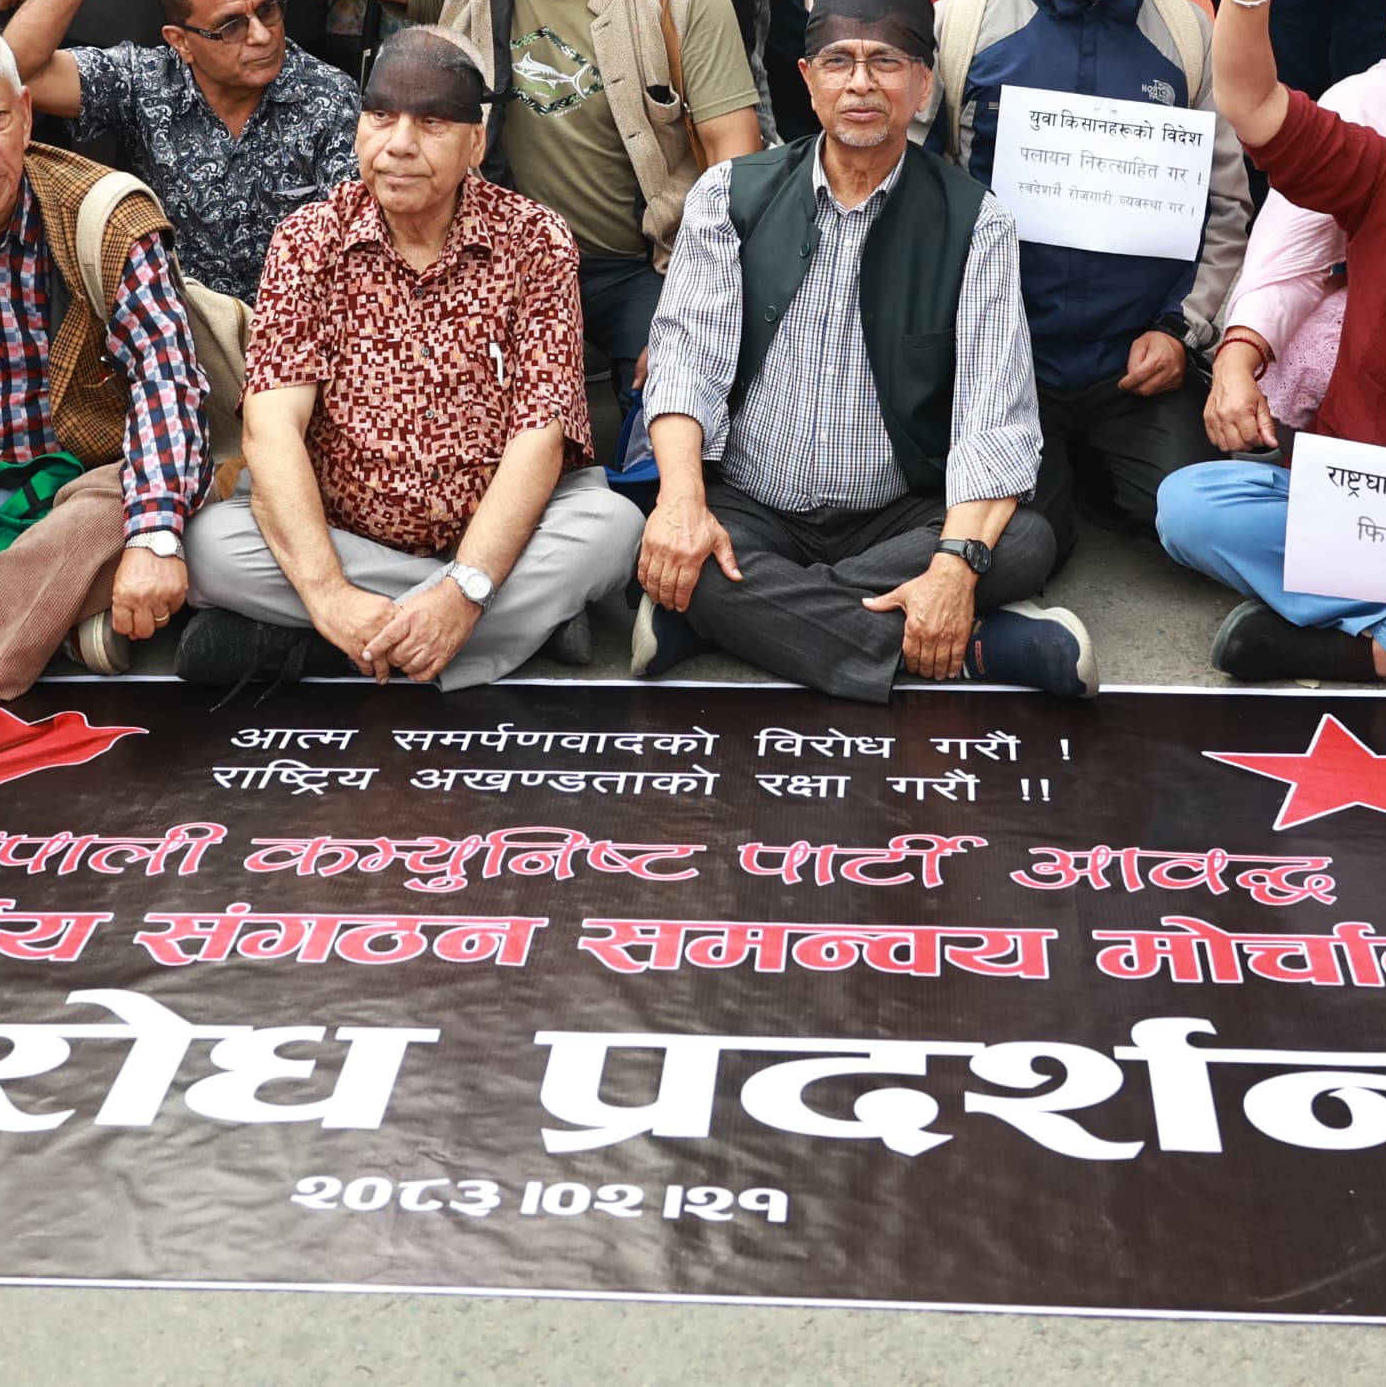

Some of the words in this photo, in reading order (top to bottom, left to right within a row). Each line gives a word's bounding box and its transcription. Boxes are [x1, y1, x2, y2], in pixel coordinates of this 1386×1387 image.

[1029, 110, 1057, 131] युवा
[1162, 122, 1204, 147] विदेश
[1019, 146, 1072, 167] पलायन
[1167, 165, 1190, 183] गर
[1068, 184, 1114, 205] रोजगारी
[1167, 201, 1187, 215] गर
[229, 726, 360, 751] आत्म
[391, 722, 721, 757] समर्पणवादको
[753, 726, 896, 759] विरोध
[211, 758, 381, 795] राष्ट्रिय
[409, 763, 721, 796] अखण्डताको
[754, 773, 852, 799] रक्षा
[242, 825, 708, 894] कम्युनिष्ट
[1008, 844, 1338, 906] आवद्ध
[132, 901, 550, 968] संगठन
[576, 916, 1059, 981] समन्वय
